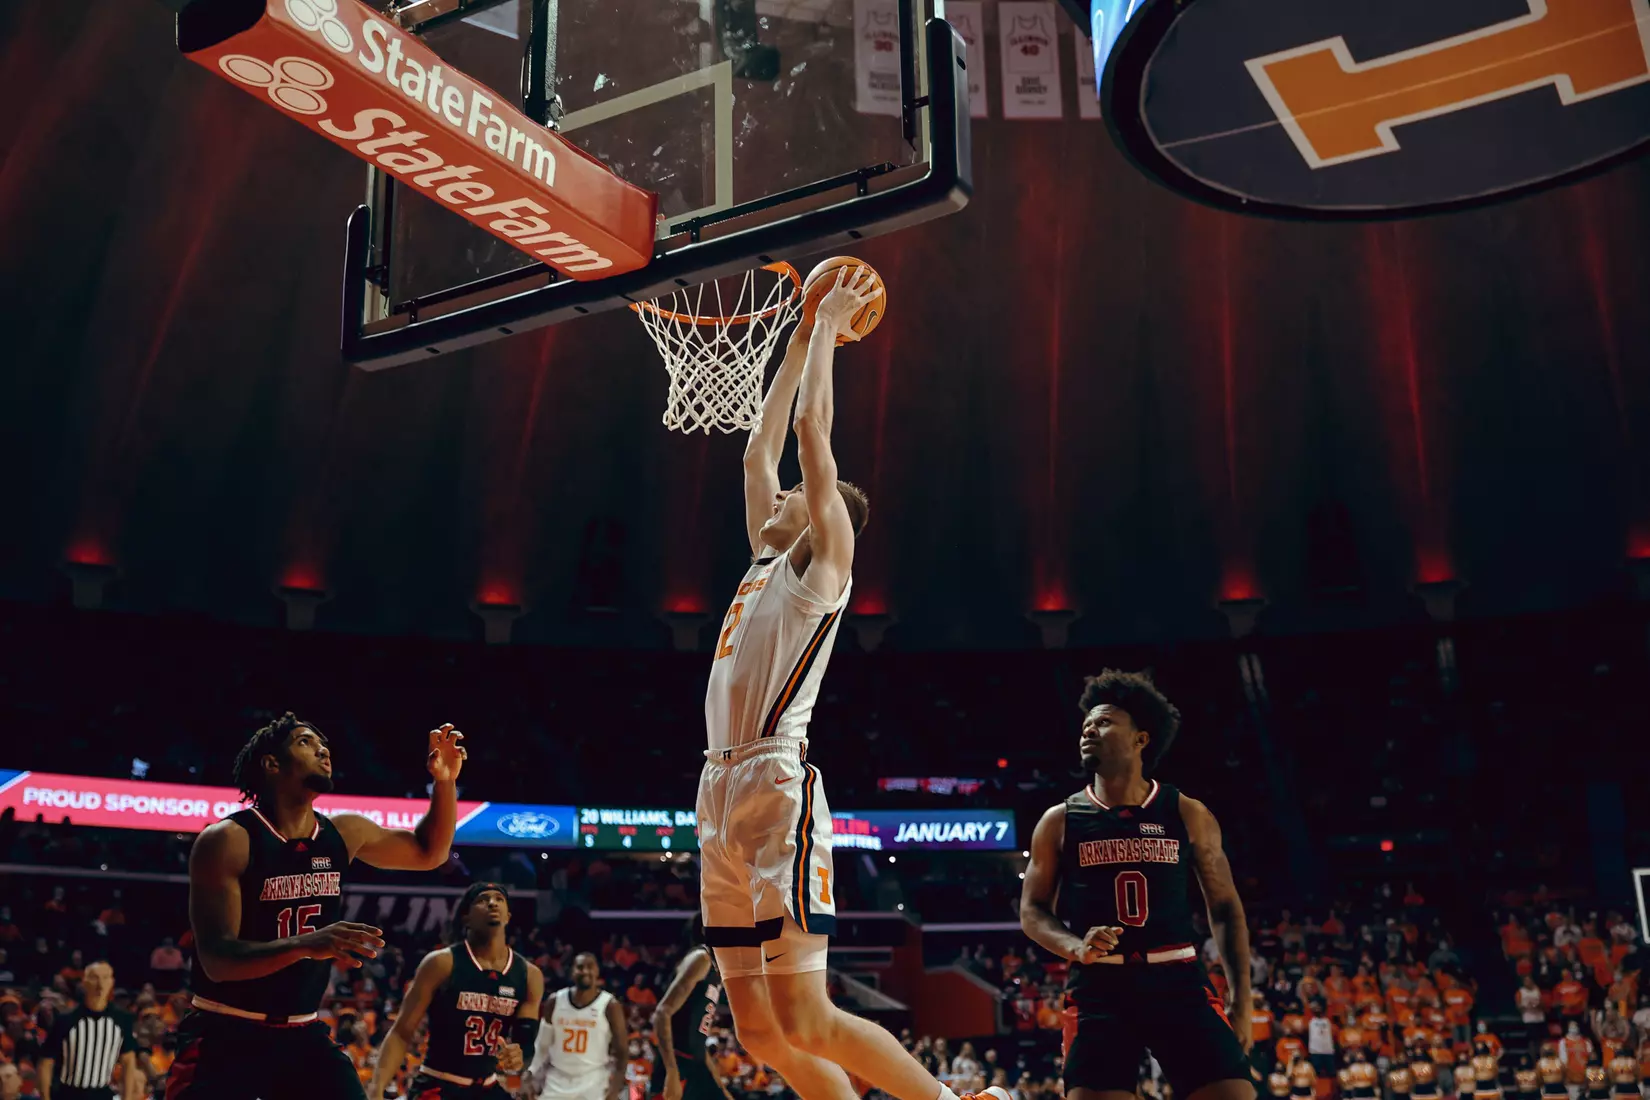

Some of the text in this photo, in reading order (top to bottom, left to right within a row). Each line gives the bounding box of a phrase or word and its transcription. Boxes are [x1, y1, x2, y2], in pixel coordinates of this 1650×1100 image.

[23, 787, 102, 810] PROUD
[104, 793, 209, 818] SPONSOR
[580, 808, 599, 825] 20
[600, 809, 673, 828] WILLIAMS,
[622, 835, 632, 849] 4
[894, 822, 1009, 843] JANUARY 7
[312, 857, 331, 869] SBC
[1114, 870, 1149, 927] 0
[463, 1016, 503, 1056] 24
[563, 1028, 588, 1054] 20
